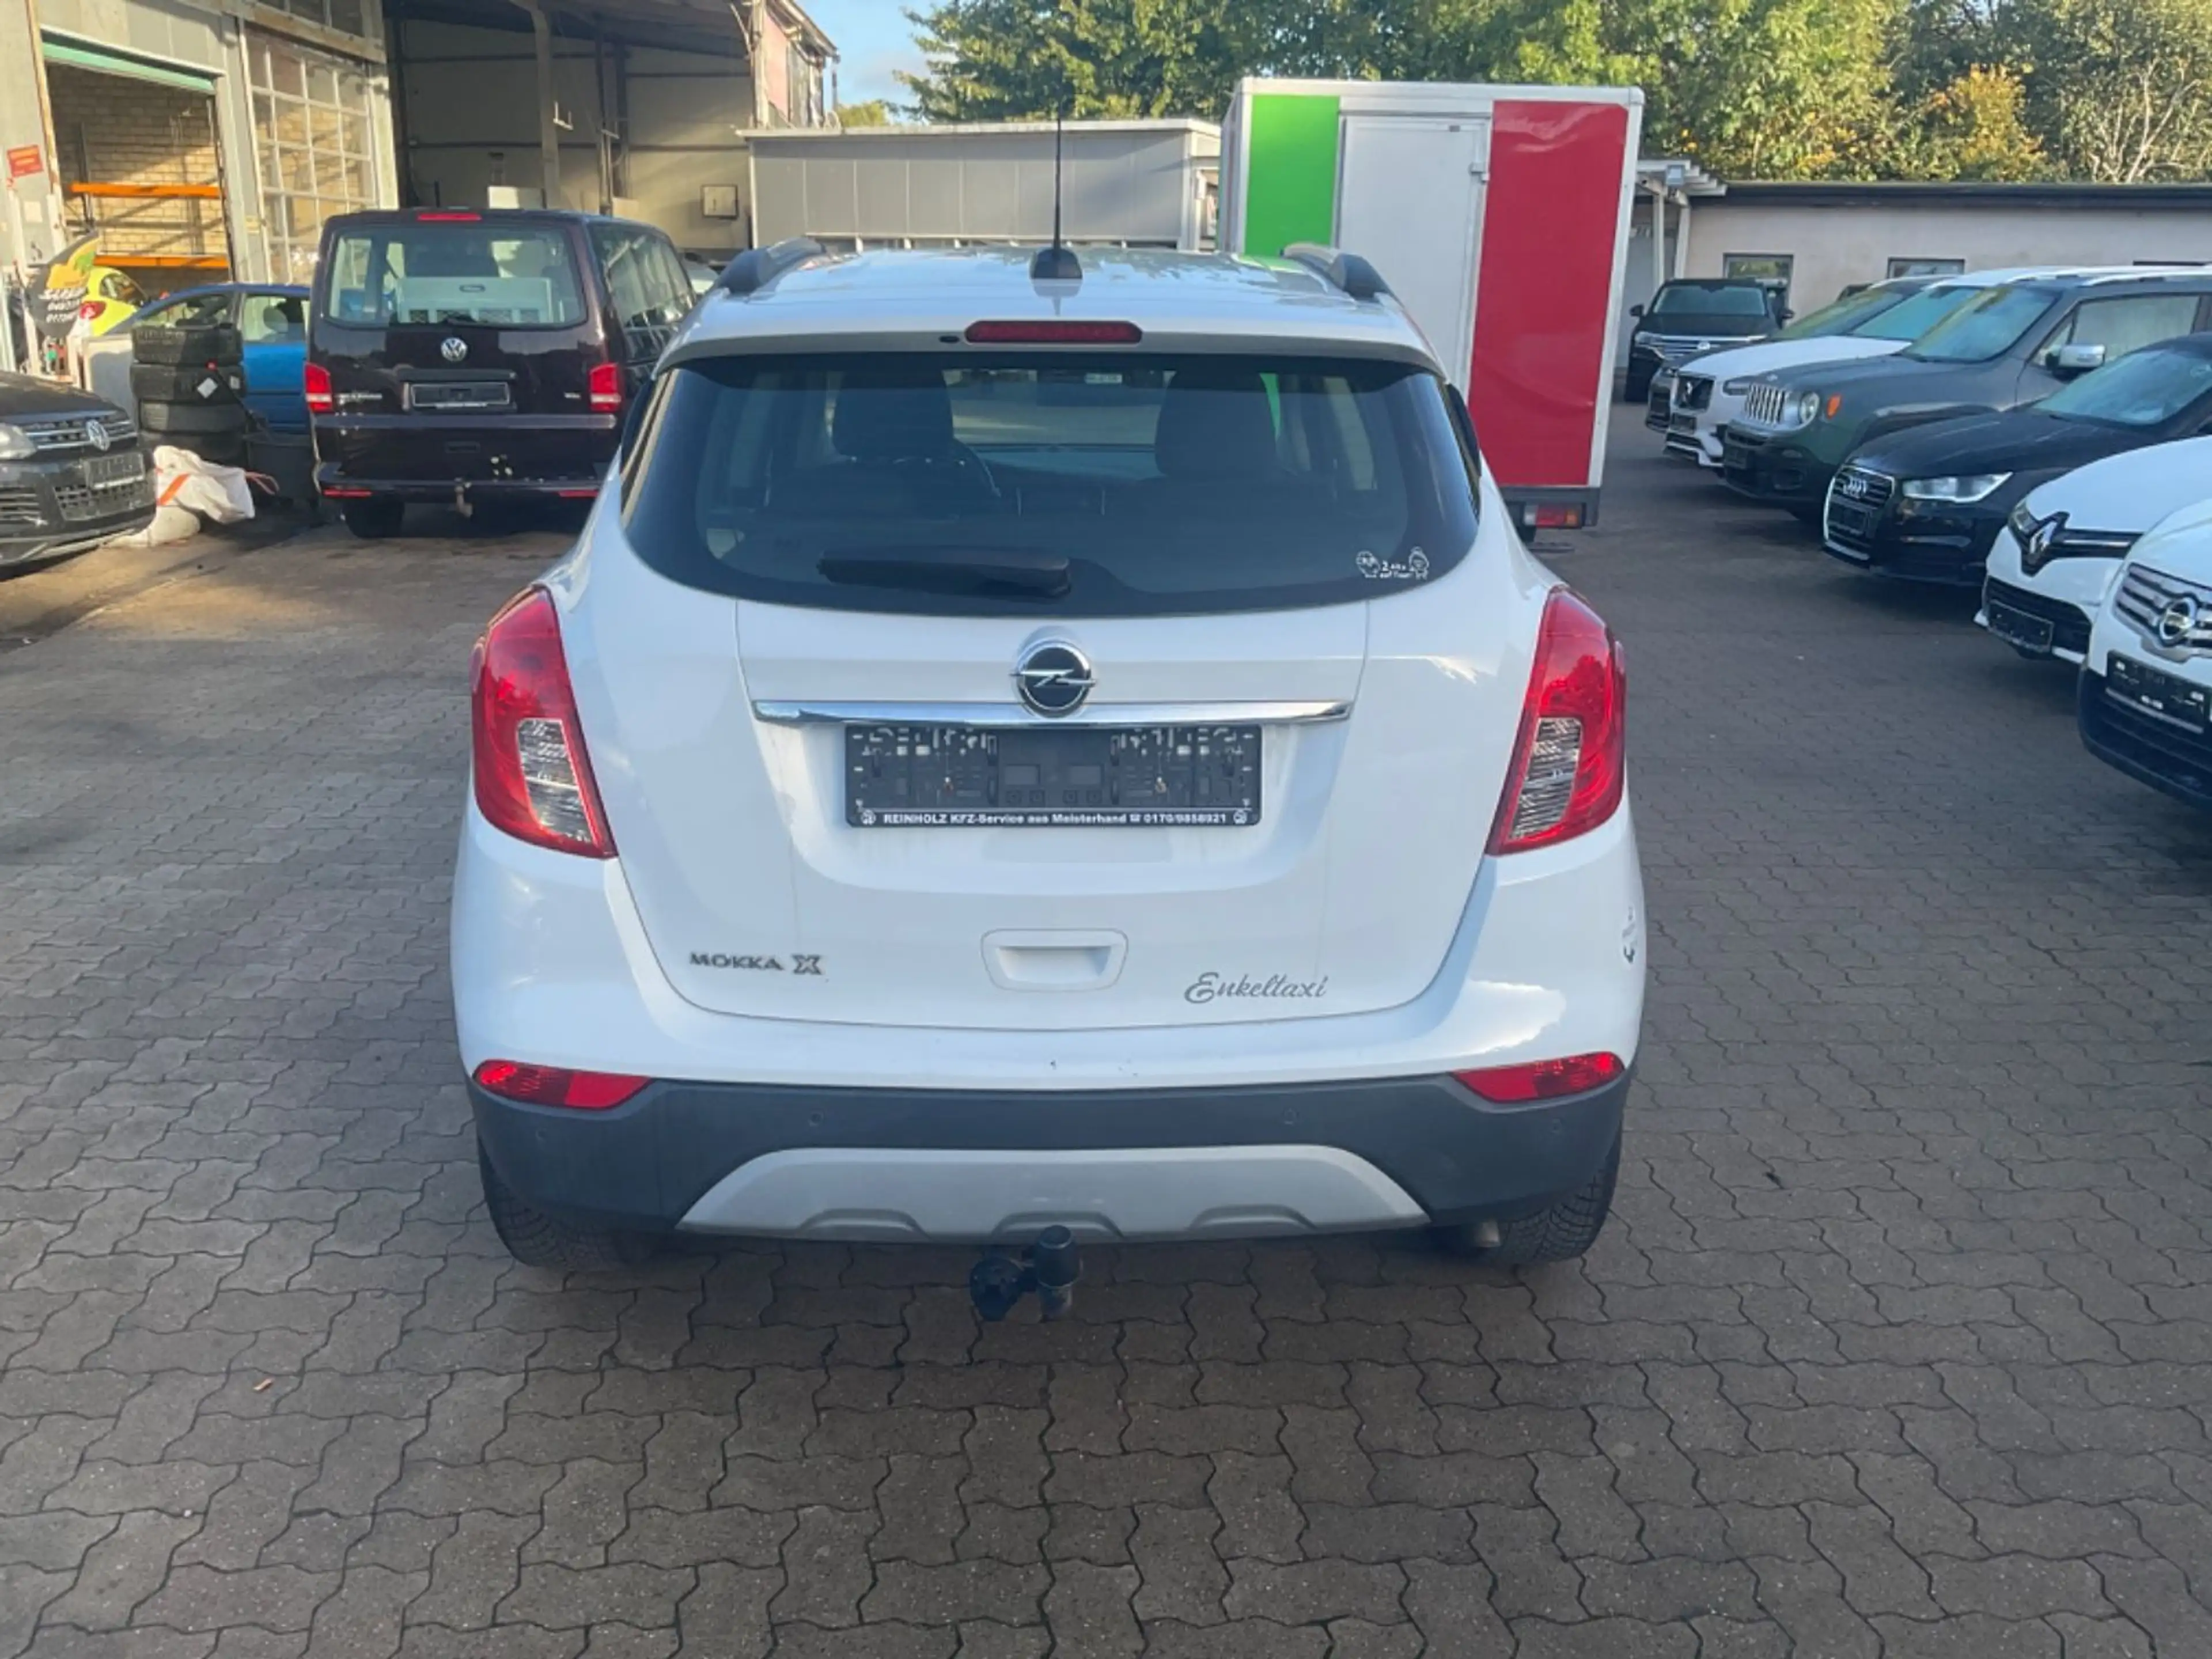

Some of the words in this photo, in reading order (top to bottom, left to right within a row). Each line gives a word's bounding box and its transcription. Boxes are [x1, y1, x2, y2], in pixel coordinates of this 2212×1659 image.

[884, 813, 948, 824] REINHOLZ
[690, 952, 785, 971] MOKKA
[791, 954, 823, 975] X
[1184, 972, 1328, 1003] Enkeltaxi
